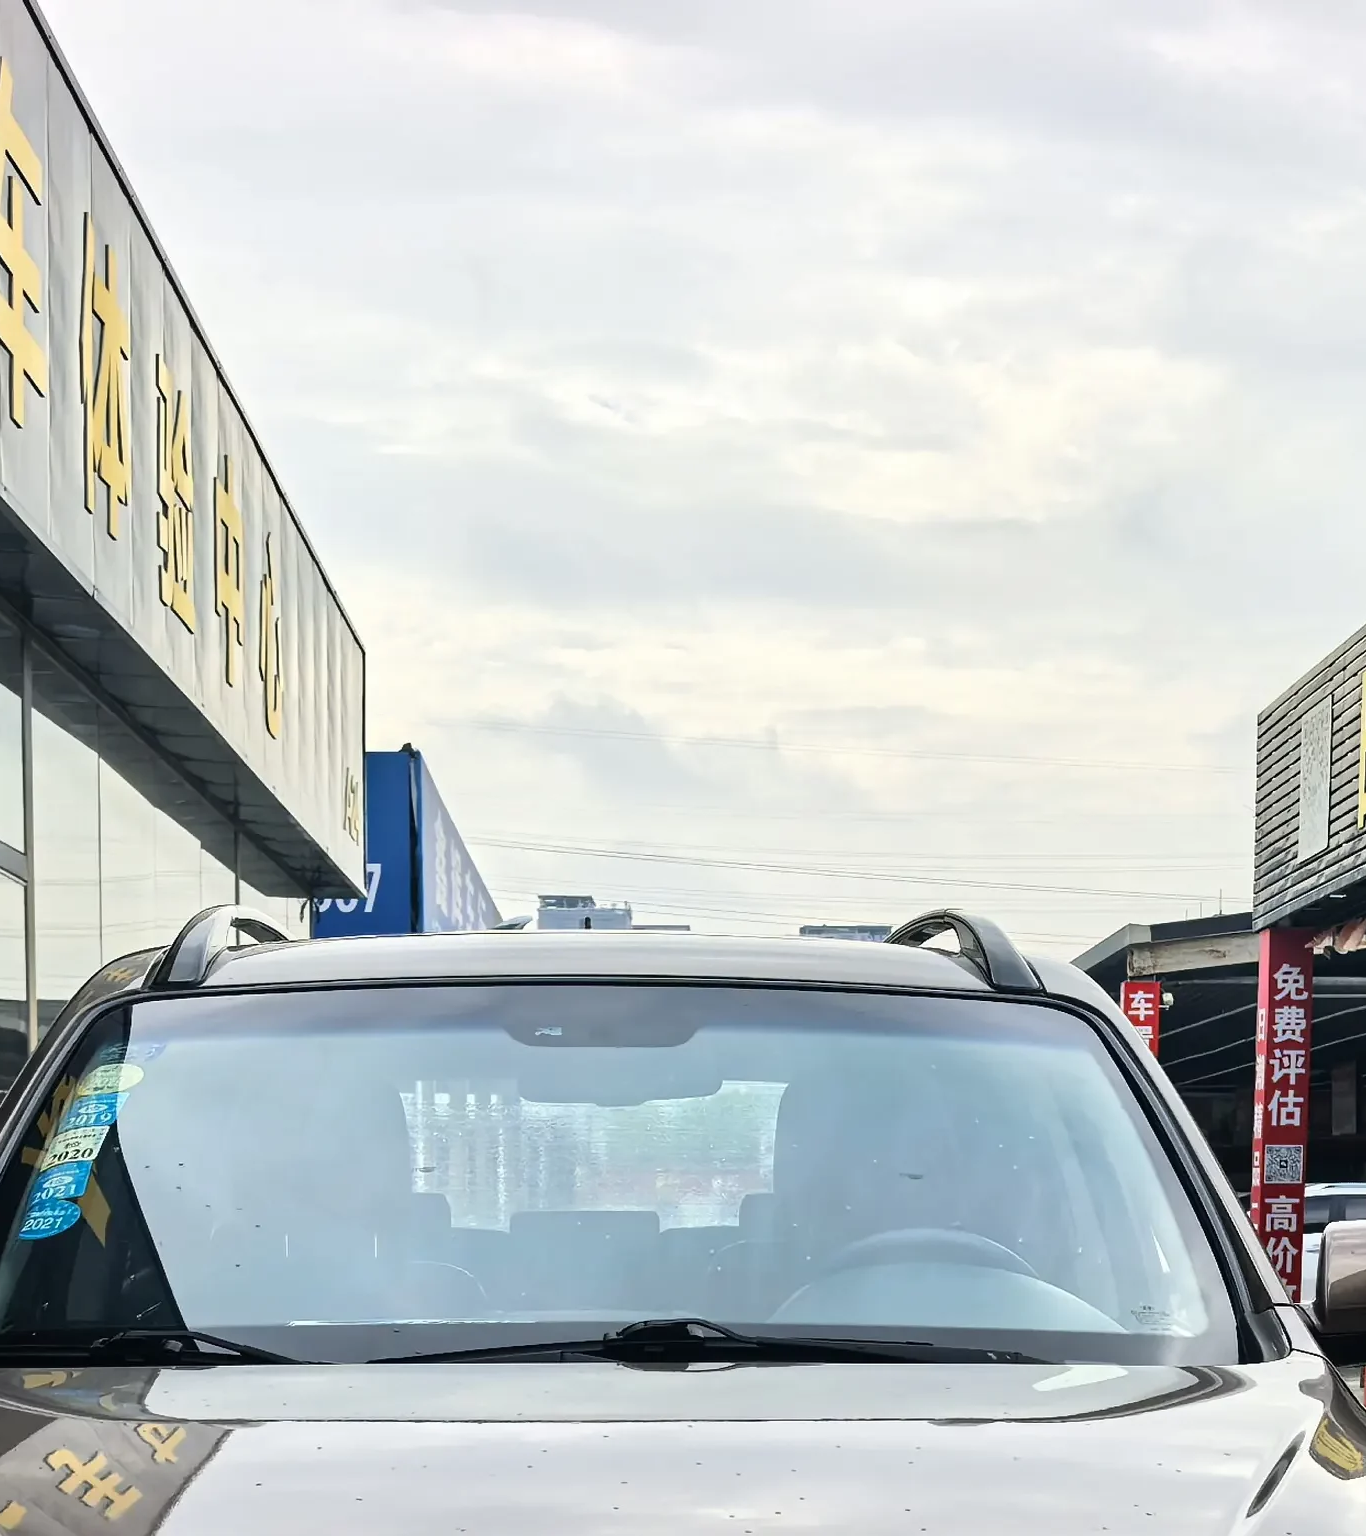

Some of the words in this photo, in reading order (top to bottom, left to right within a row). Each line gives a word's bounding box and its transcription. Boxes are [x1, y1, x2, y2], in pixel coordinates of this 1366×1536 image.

[1268, 963, 1309, 1127] 免费评估
[46, 1147, 94, 1166] 2020
[21, 1216, 65, 1233] 2021
